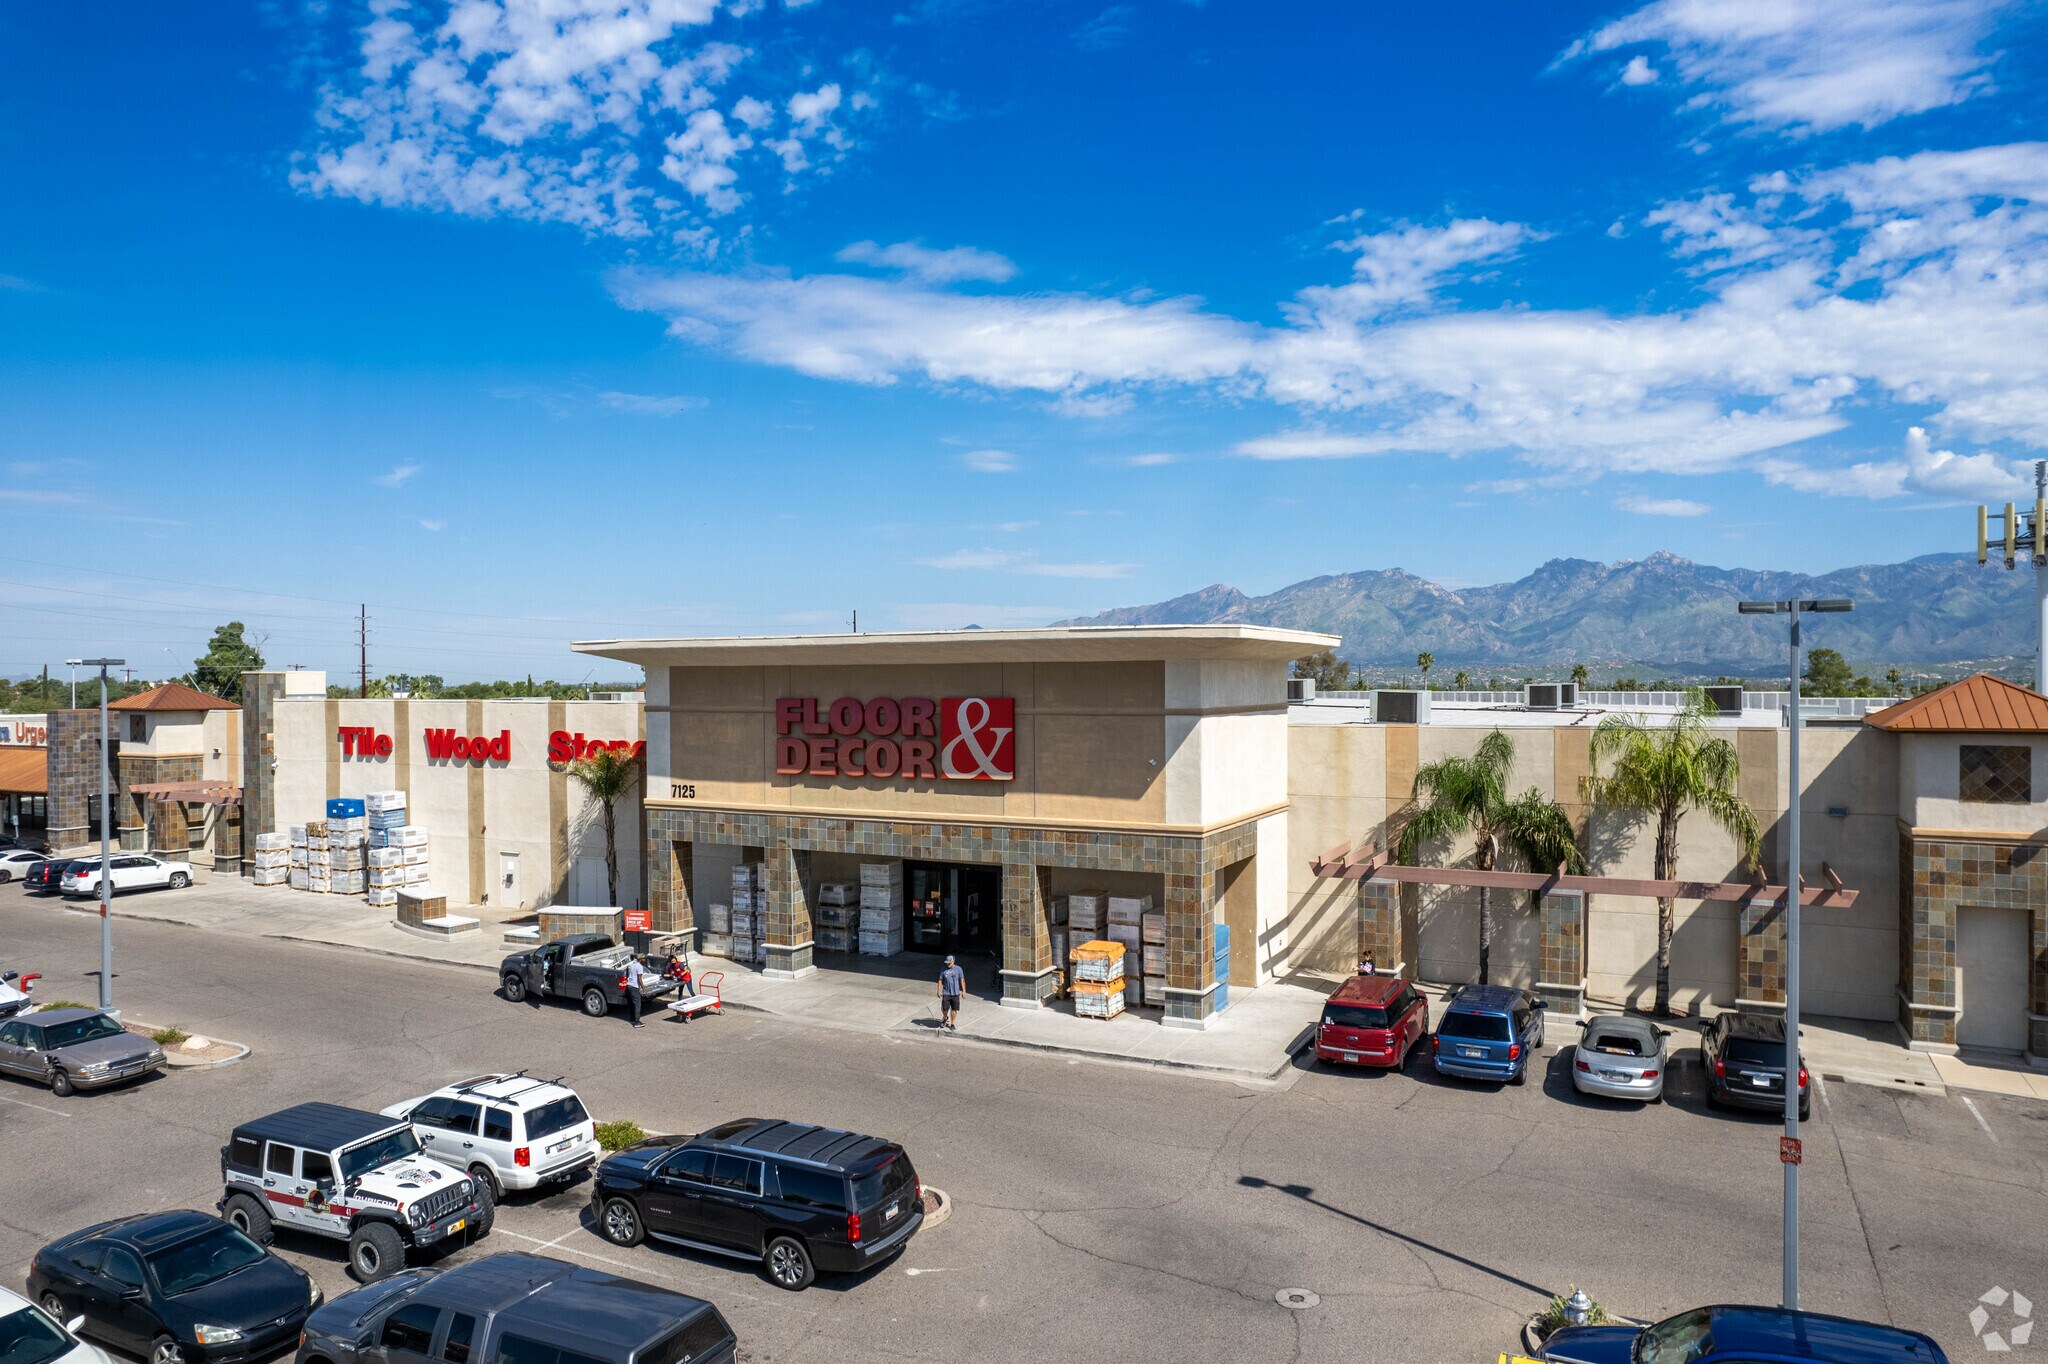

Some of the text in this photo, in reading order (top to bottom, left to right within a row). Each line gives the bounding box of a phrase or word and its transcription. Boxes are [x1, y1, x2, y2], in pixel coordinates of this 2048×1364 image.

[15, 721, 48, 747] Urge
[776, 697, 936, 737] FLOOR
[338, 726, 393, 756] Tile
[424, 728, 511, 761] Wood
[942, 697, 1014, 781] &
[776, 737, 937, 779] DECOR
[671, 784, 696, 799] 7125
[354, 1194, 397, 1208] RUBICON
